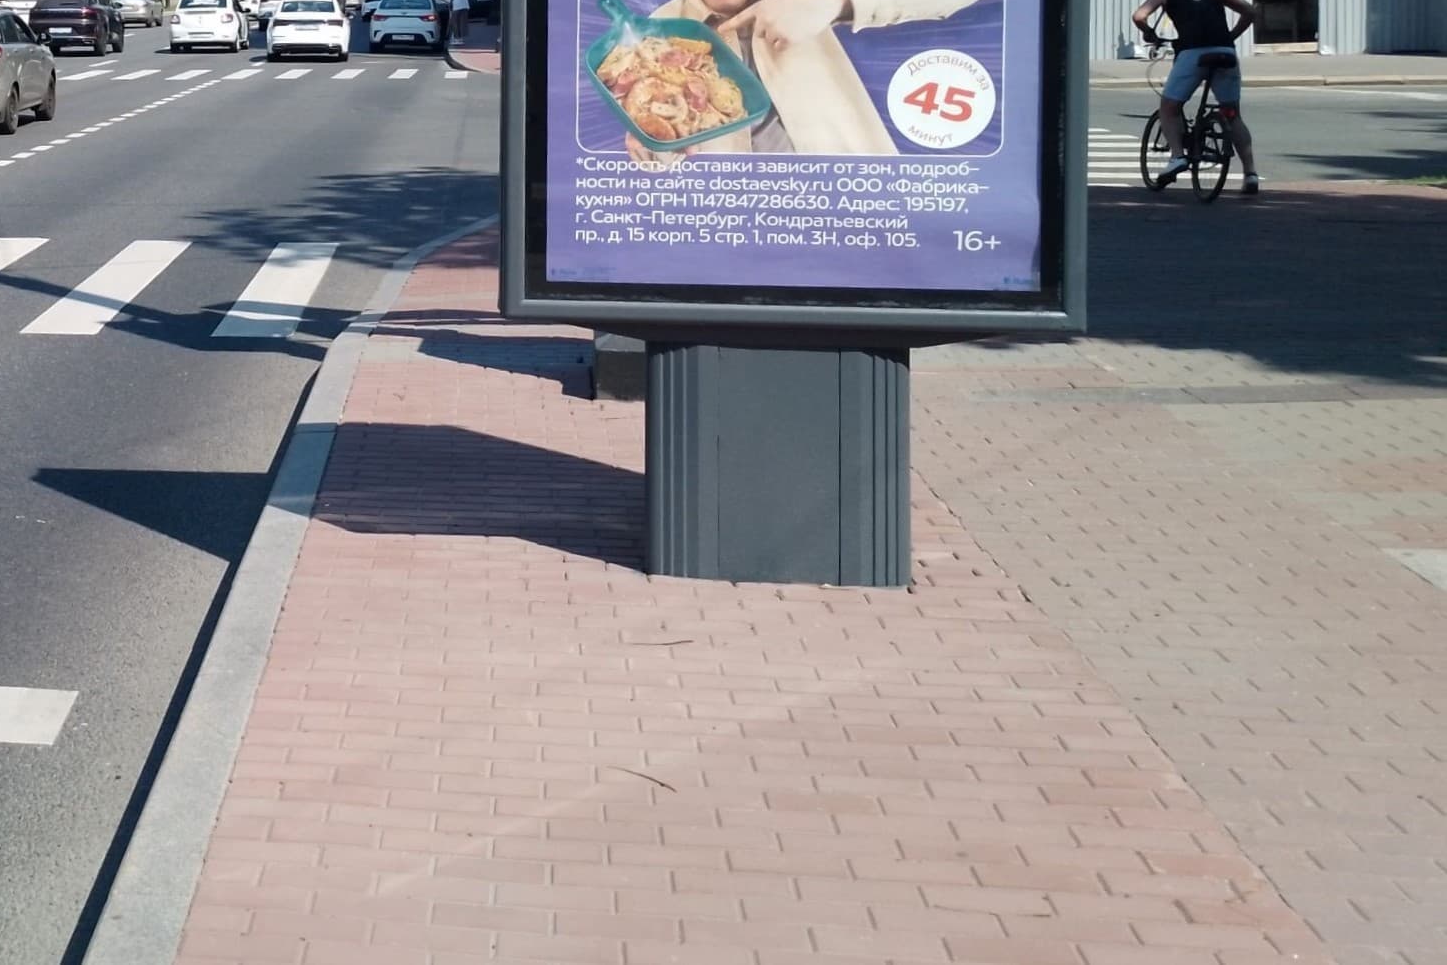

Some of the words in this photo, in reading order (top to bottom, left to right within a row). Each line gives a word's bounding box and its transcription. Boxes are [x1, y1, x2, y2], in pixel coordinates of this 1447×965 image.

[906, 55, 977, 76] Доставим
[976, 75, 990, 91] за
[903, 82, 976, 122] 45
[908, 125, 953, 146] минут
[670, 160, 753, 174] доставки
[757, 161, 830, 174] зависит
[833, 163, 855, 174] от
[858, 163, 895, 176] зон,
[900, 162, 980, 176] подроб-
[575, 177, 625, 188] ности
[630, 178, 651, 189] на
[654, 175, 705, 190] сайте
[709, 176, 832, 194] dostaevsky.ru
[837, 178, 882, 192] ООО
[575, 194, 631, 208] кухня»
[636, 193, 687, 207] ОГРН
[691, 193, 833, 210] 1147847286630.
[837, 196, 900, 213] Адрес:
[905, 197, 969, 214] 195197,
[575, 213, 587, 223] г.
[591, 209, 751, 228] Санкт-Петербург,
[755, 211, 908, 230] Кондратьевский
[575, 229, 604, 244] пр.,
[608, 230, 623, 243] д.
[627, 228, 645, 241] 15
[649, 230, 695, 245] корп.
[699, 229, 710, 242] 5
[714, 231, 749, 246] стр.
[752, 229, 763, 245] 1,
[767, 233, 807, 245] пом.
[811, 231, 840, 247] 3Н,
[844, 232, 880, 249] оф.
[885, 233, 920, 248] 105.
[953, 230, 1001, 252] 16+
